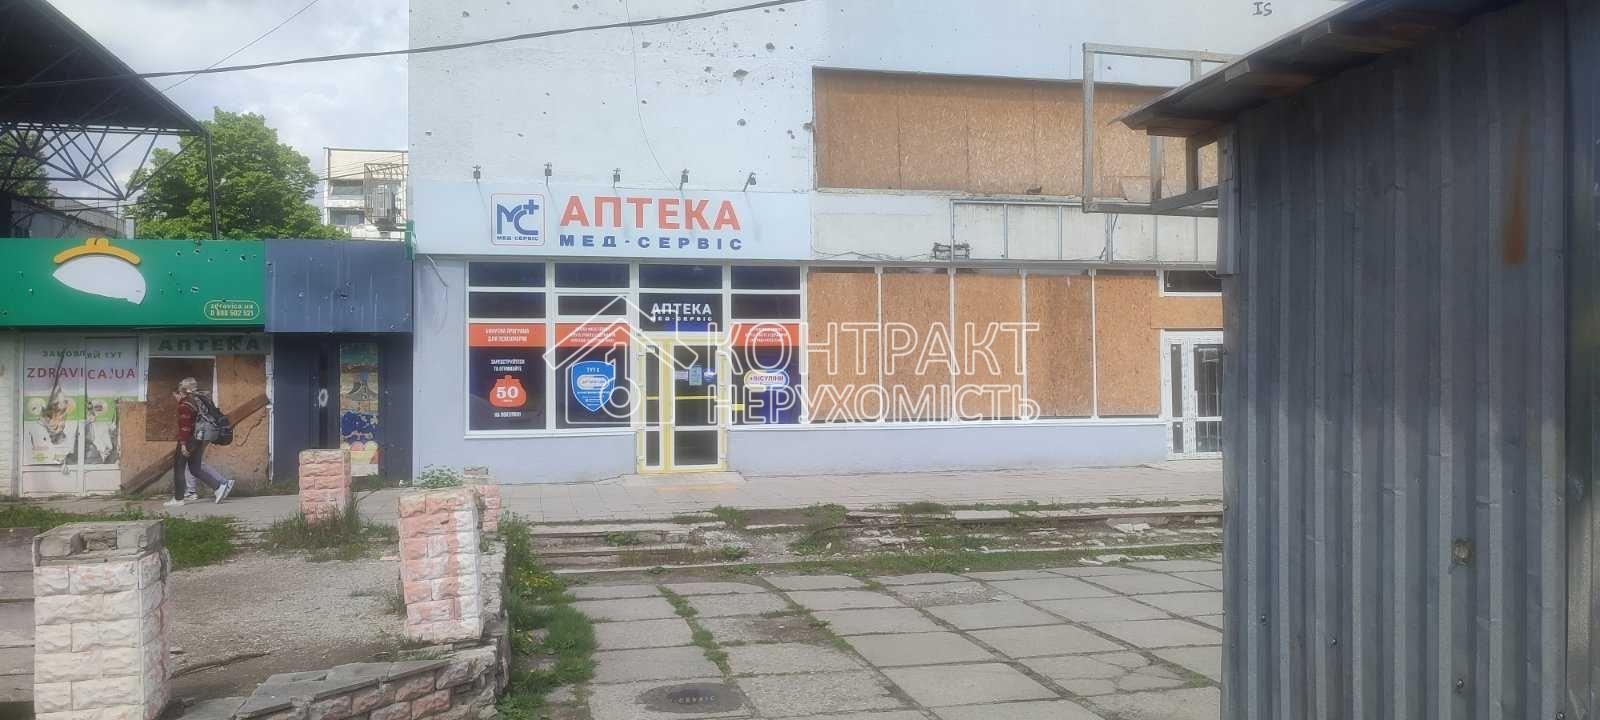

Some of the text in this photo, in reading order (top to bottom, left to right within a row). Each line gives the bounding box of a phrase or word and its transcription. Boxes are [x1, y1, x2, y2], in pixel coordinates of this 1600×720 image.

[559, 194, 741, 231] АПТЕКА
[559, 234, 742, 250] МЕД-СЕРВІС
[651, 303, 712, 315] АПТЕКА
[158, 338, 259, 352] АПТЕКА
[496, 386, 518, 399] 50
